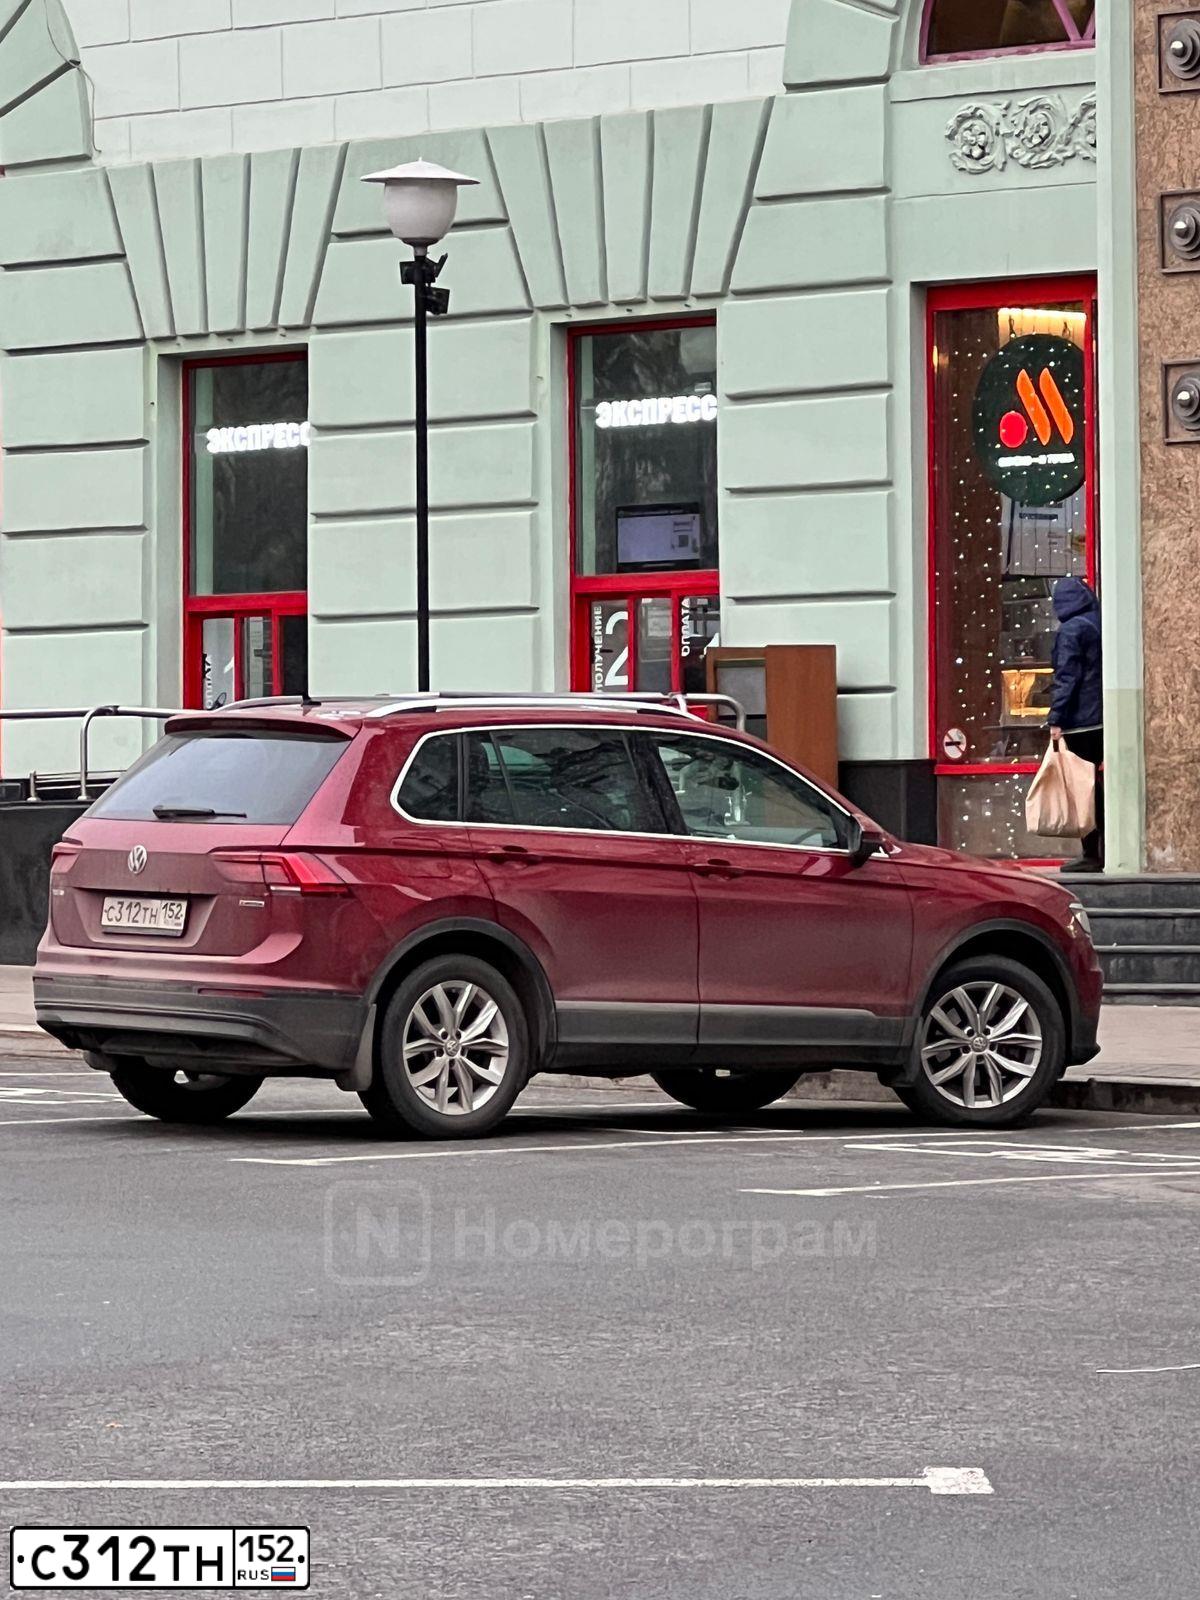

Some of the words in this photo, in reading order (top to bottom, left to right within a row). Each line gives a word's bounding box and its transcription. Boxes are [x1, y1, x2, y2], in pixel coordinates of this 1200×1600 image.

[595, 394, 717, 428] ЭКСПРЕСС
[593, 606, 604, 693] ПОЛУЧЕНИЕ
[604, 611, 629, 687] 2
[681, 598, 691, 657] ОПЛАТА
[106, 900, 158, 924] С312ТН
[162, 902, 183, 920] 152
